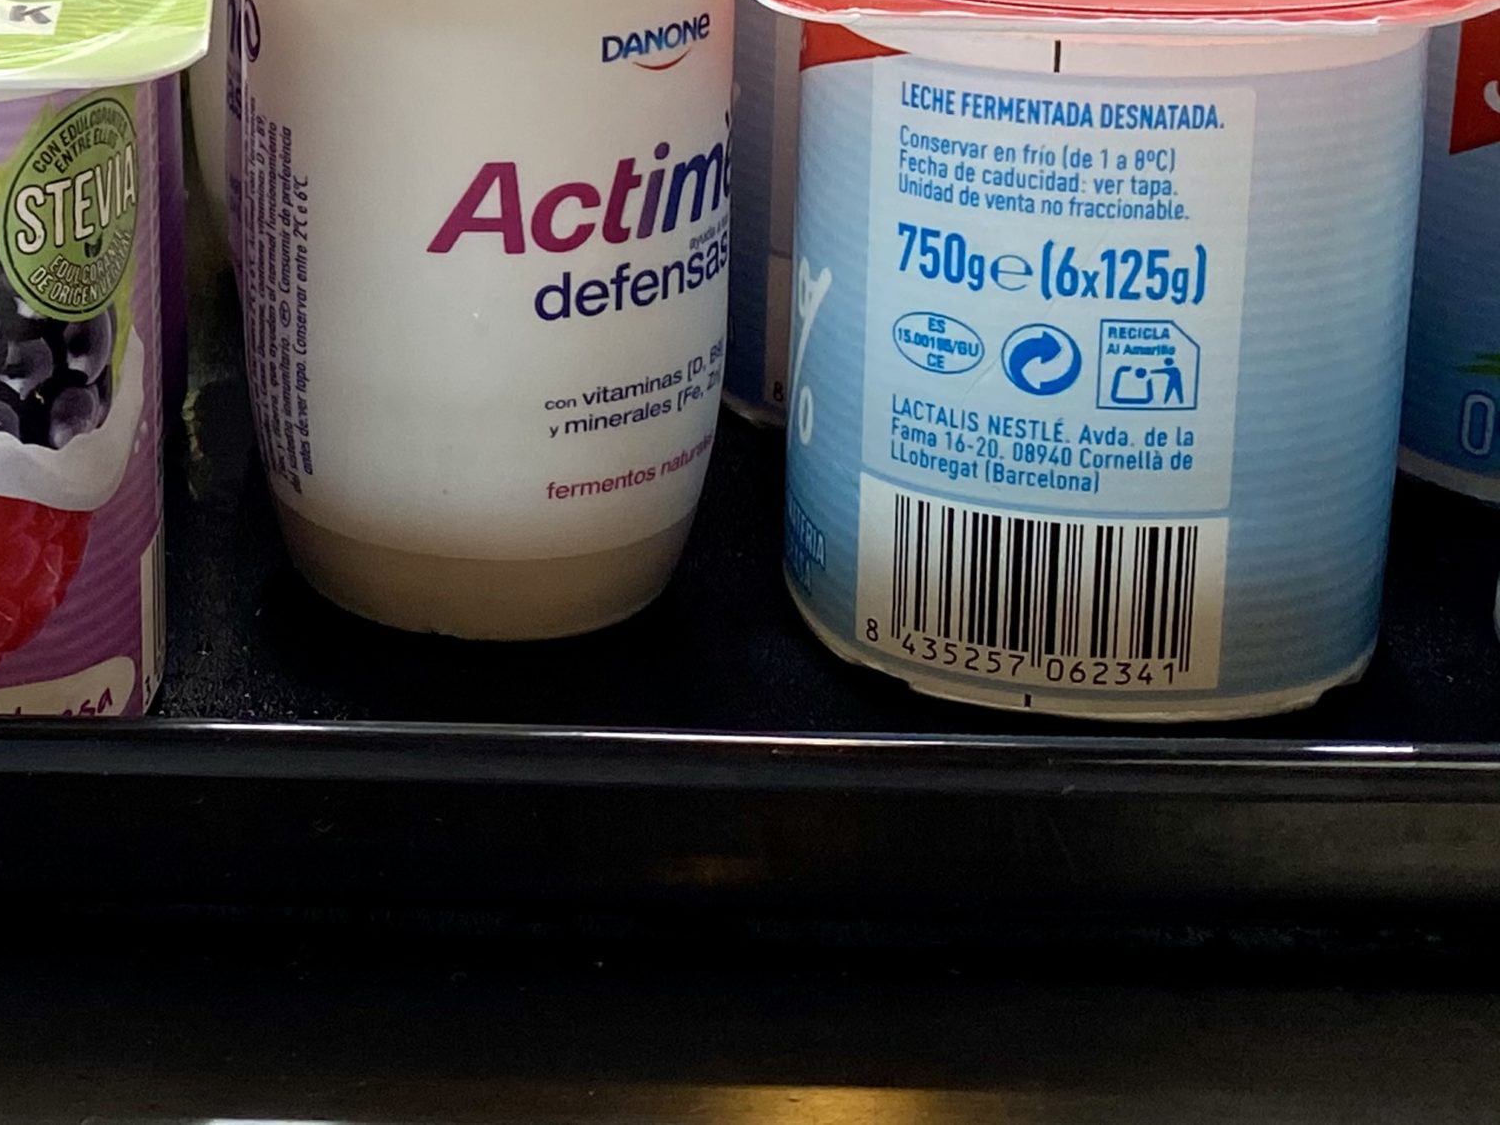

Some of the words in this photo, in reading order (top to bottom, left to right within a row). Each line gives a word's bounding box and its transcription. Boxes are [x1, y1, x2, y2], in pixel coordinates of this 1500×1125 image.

[9, 4, 52, 24] K
[901, 81, 955, 115] LECHE
[961, 92, 1093, 128] FERMENTADA
[1100, 103, 1225, 131] DESNATADA.
[32, 139, 62, 174] CON
[900, 125, 988, 159] Conservar
[994, 146, 1016, 163] en
[1023, 143, 1056, 167] frío
[1062, 145, 1093, 170] (de
[1100, 148, 1108, 169] 1
[1116, 154, 1128, 171] a
[899, 149, 948, 178] Fecha
[955, 163, 975, 183] de
[982, 167, 1087, 195] caducidad:
[1093, 177, 1124, 196] ver
[1131, 177, 1178, 200] tapa.
[14, 140, 137, 255] STEVIA
[899, 173, 953, 203] Unidad
[959, 185, 980, 208] de
[985, 189, 1035, 215] venta
[1041, 198, 1064, 216] no
[1068, 196, 1190, 221] fraccionable.
[28, 265, 54, 294] DE
[294, 244, 308, 283] entre
[534, 230, 728, 321] defensas
[1040, 239, 1208, 305] (6x125g)
[927, 317, 946, 334] ES
[1108, 326, 1171, 341] RECICLA
[926, 353, 946, 370] CE
[545, 397, 577, 411] con
[582, 369, 682, 406] vitaminas
[773, 381, 785, 403] 8
[549, 425, 559, 439] y
[564, 398, 672, 435] minerales
[892, 393, 978, 433] LACTALIS
[988, 414, 1071, 444] NESTLÉ.
[1079, 425, 1135, 448] Avda.
[1144, 426, 1168, 448] de
[1176, 426, 1195, 448] la
[891, 417, 938, 449] Fama
[1013, 442, 1072, 467] 08940
[1079, 448, 1164, 470] Cornellà
[1170, 450, 1193, 470] de
[546, 466, 656, 500] fermentos
[890, 440, 978, 480] LLobregat
[985, 462, 1100, 494] (Barcelona)
[865, 618, 879, 642] 8
[902, 632, 1025, 676] 435257
[1046, 658, 1175, 686] 062341
